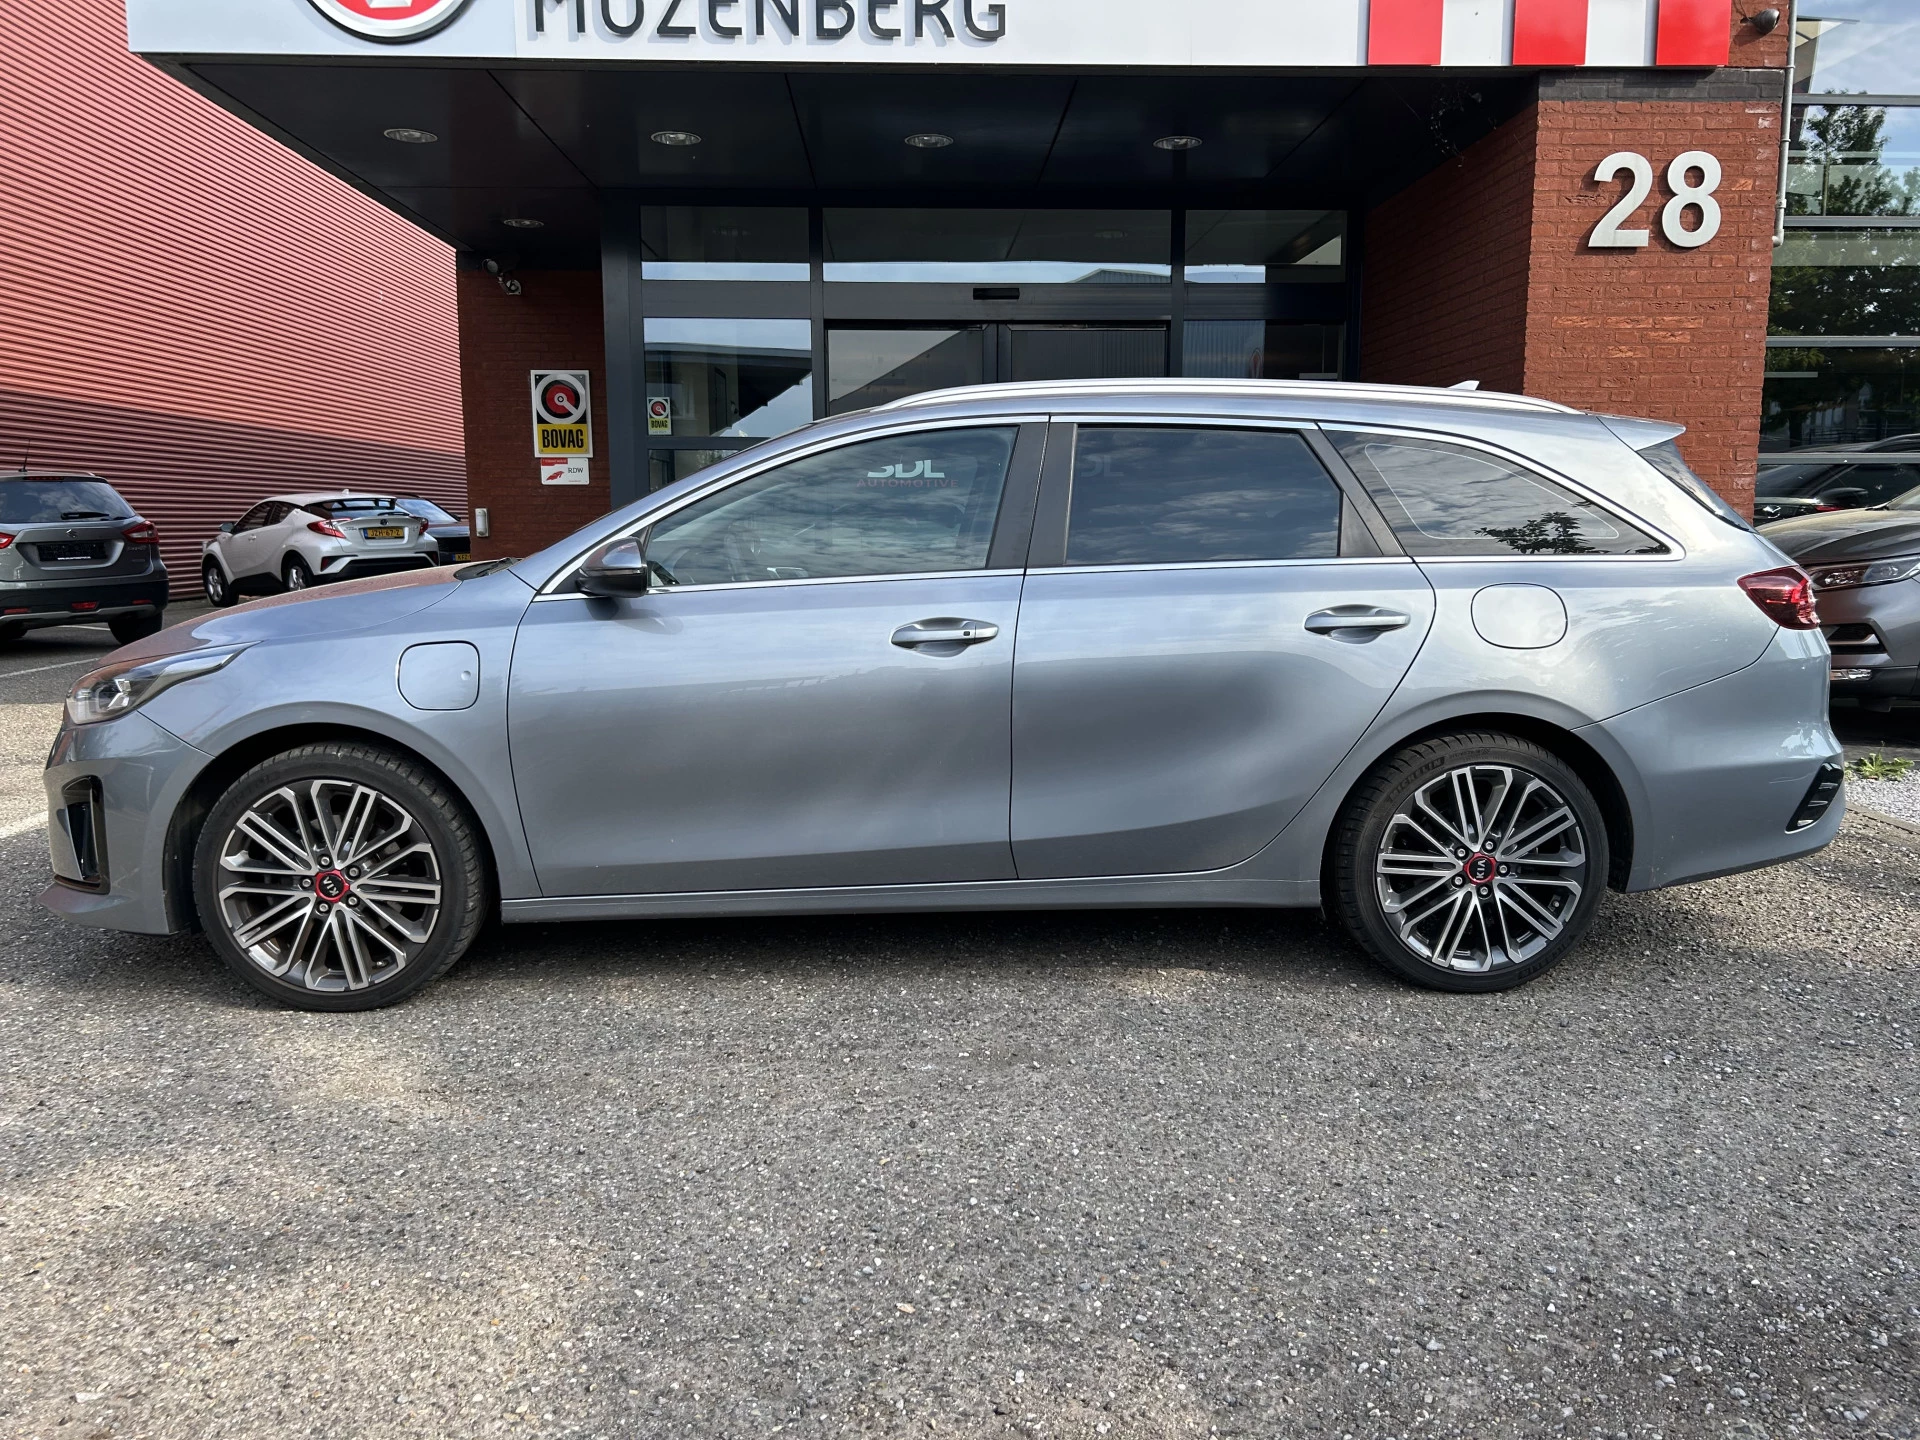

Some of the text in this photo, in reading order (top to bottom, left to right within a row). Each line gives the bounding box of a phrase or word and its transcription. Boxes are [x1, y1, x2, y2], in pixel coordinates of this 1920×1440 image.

[1588, 150, 1722, 248] 28
[650, 419, 668, 429] BOVAG
[541, 428, 584, 449] BOVAG
[856, 478, 959, 488] AUTOMOTIVE
